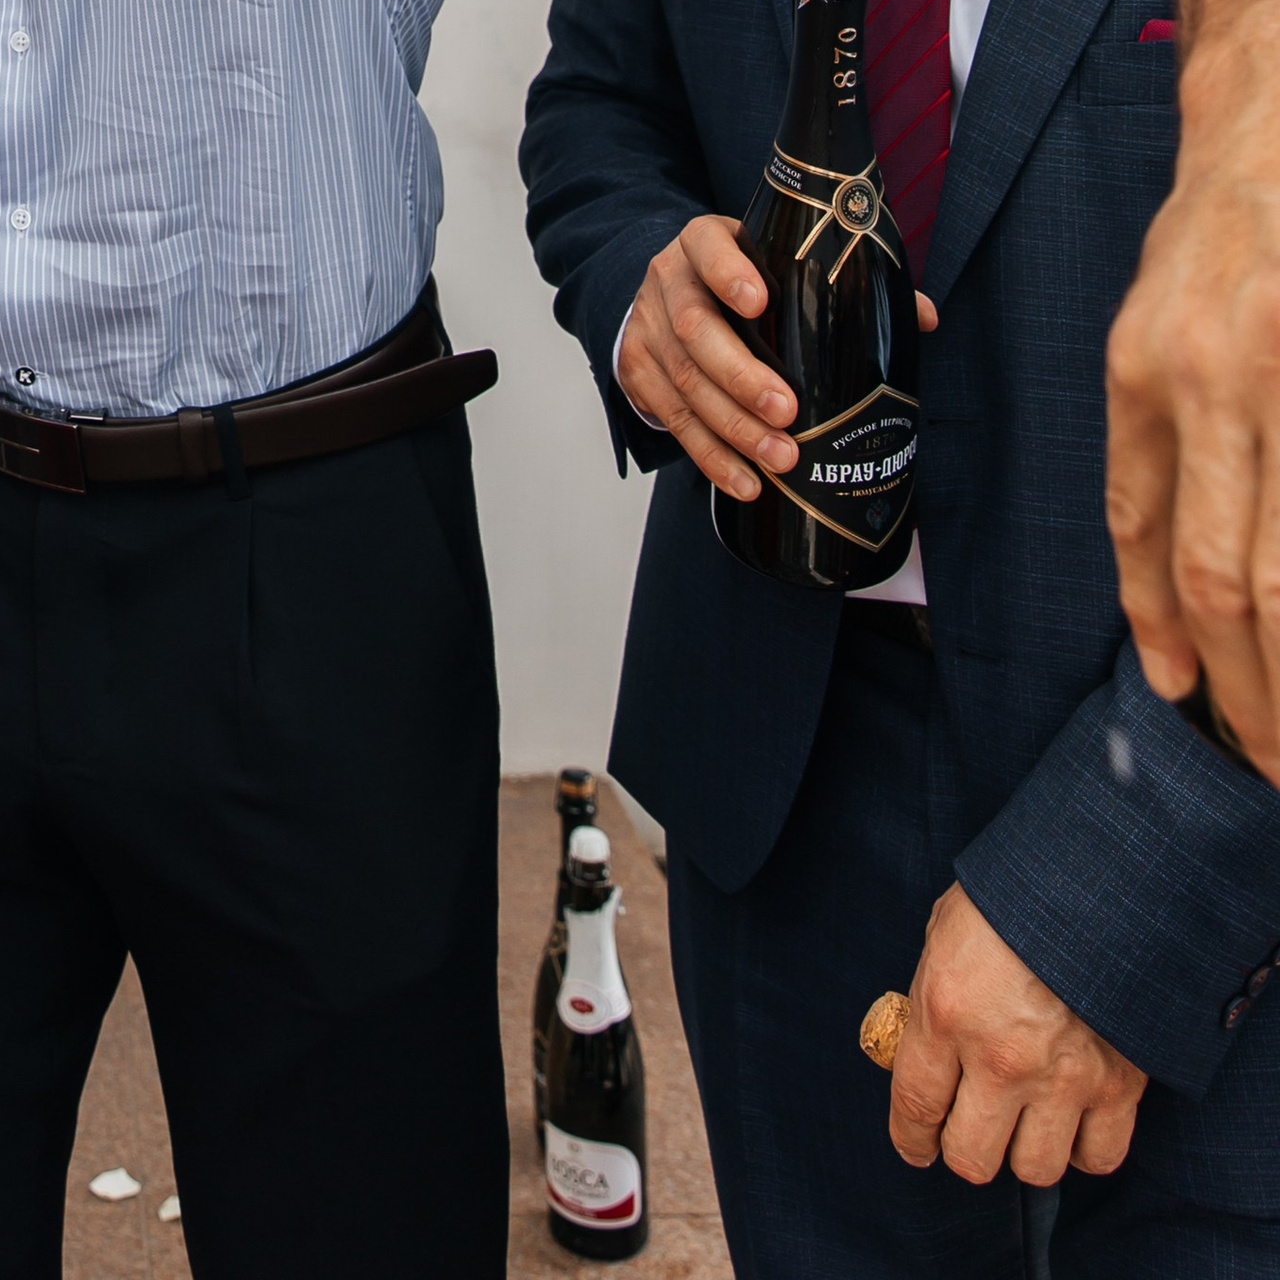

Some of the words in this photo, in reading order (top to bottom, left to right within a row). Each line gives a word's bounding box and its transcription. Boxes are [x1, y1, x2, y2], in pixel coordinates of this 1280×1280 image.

[833, 27, 858, 107] 1870
[19, 369, 32, 384] K
[832, 422, 878, 450] РУССКОЕ
